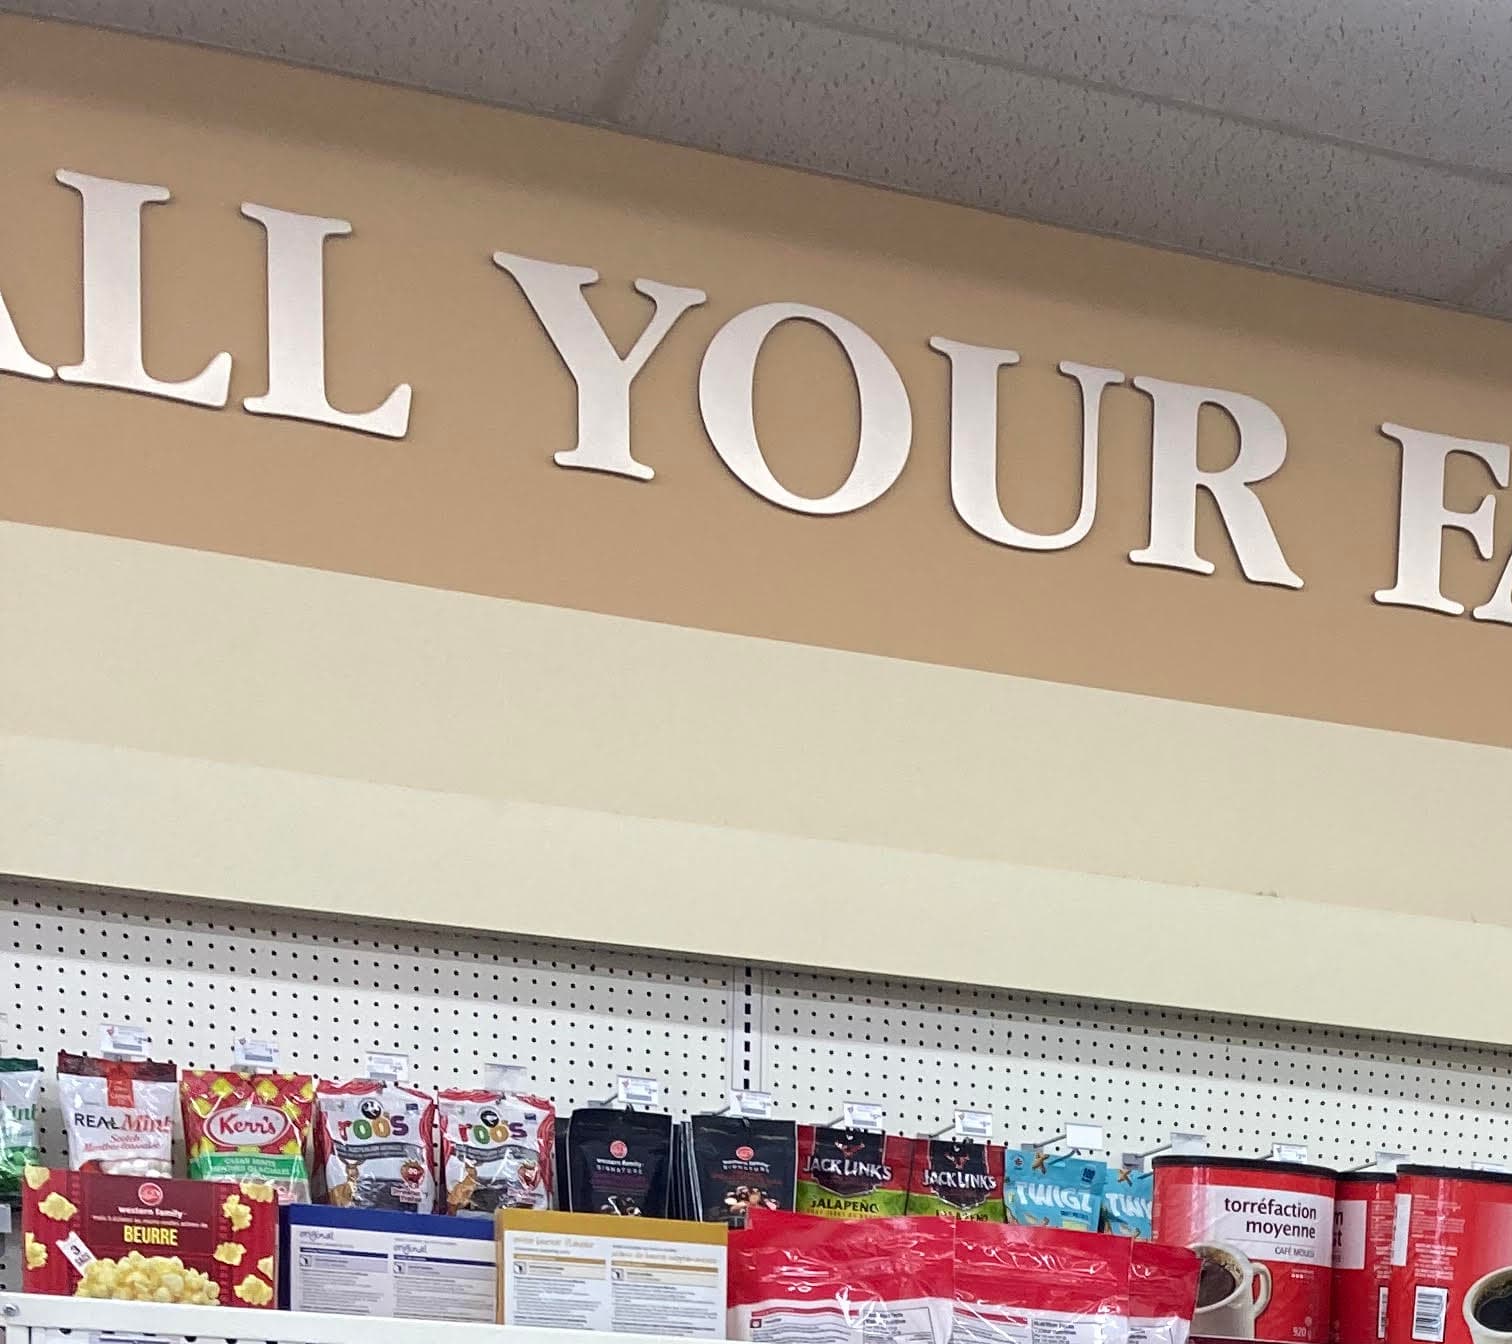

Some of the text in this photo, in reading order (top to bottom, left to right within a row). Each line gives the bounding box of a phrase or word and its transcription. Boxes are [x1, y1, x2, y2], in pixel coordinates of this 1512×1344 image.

[0, 169, 412, 439] LL
[494, 250, 1304, 589] YOUR
[219, 1117, 280, 1135] Kerr's
[1225, 1198, 1317, 1219] torréfaction
[124, 1226, 178, 1246] BEURRE
[1246, 1218, 1316, 1239] moyenne
